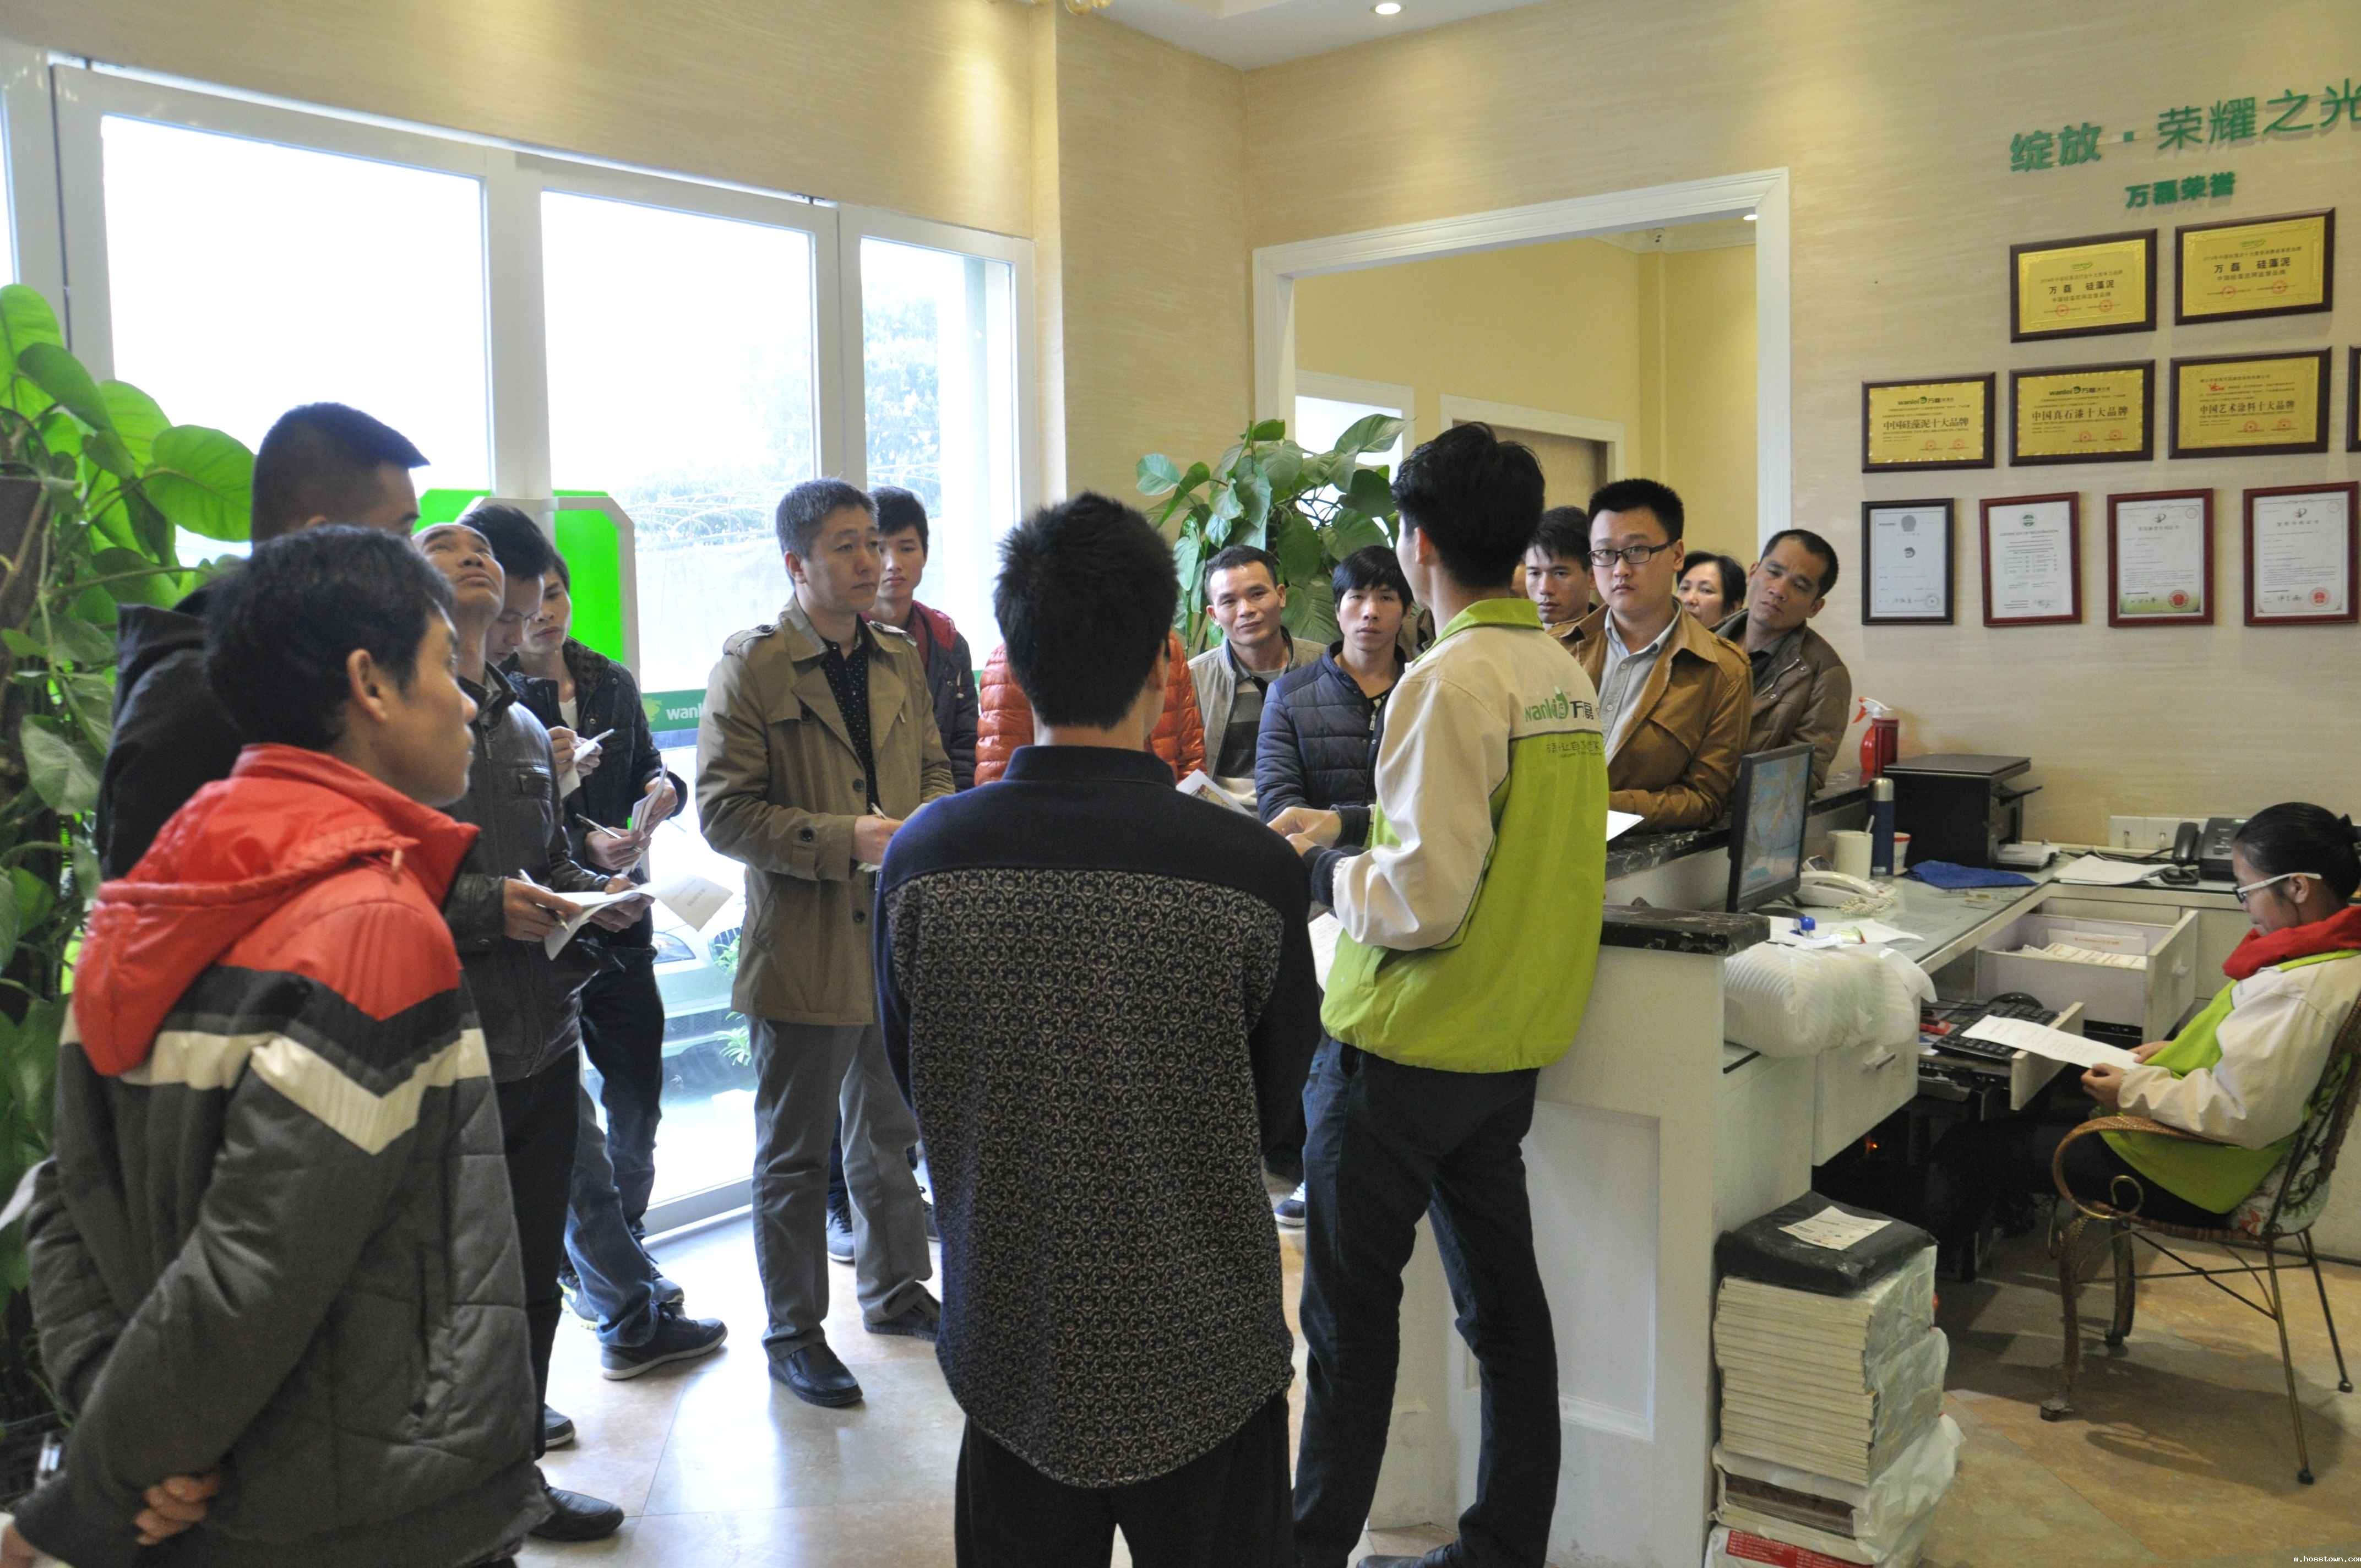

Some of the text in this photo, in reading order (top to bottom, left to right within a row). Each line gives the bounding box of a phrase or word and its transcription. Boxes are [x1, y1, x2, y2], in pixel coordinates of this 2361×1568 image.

[2125, 171, 2235, 209] 万磊荣誉
[2257, 257, 2291, 269] 硅藻泥
[2085, 280, 2115, 291] 硅藻泥
[2032, 406, 2128, 421] 中国真石漆十大品牌
